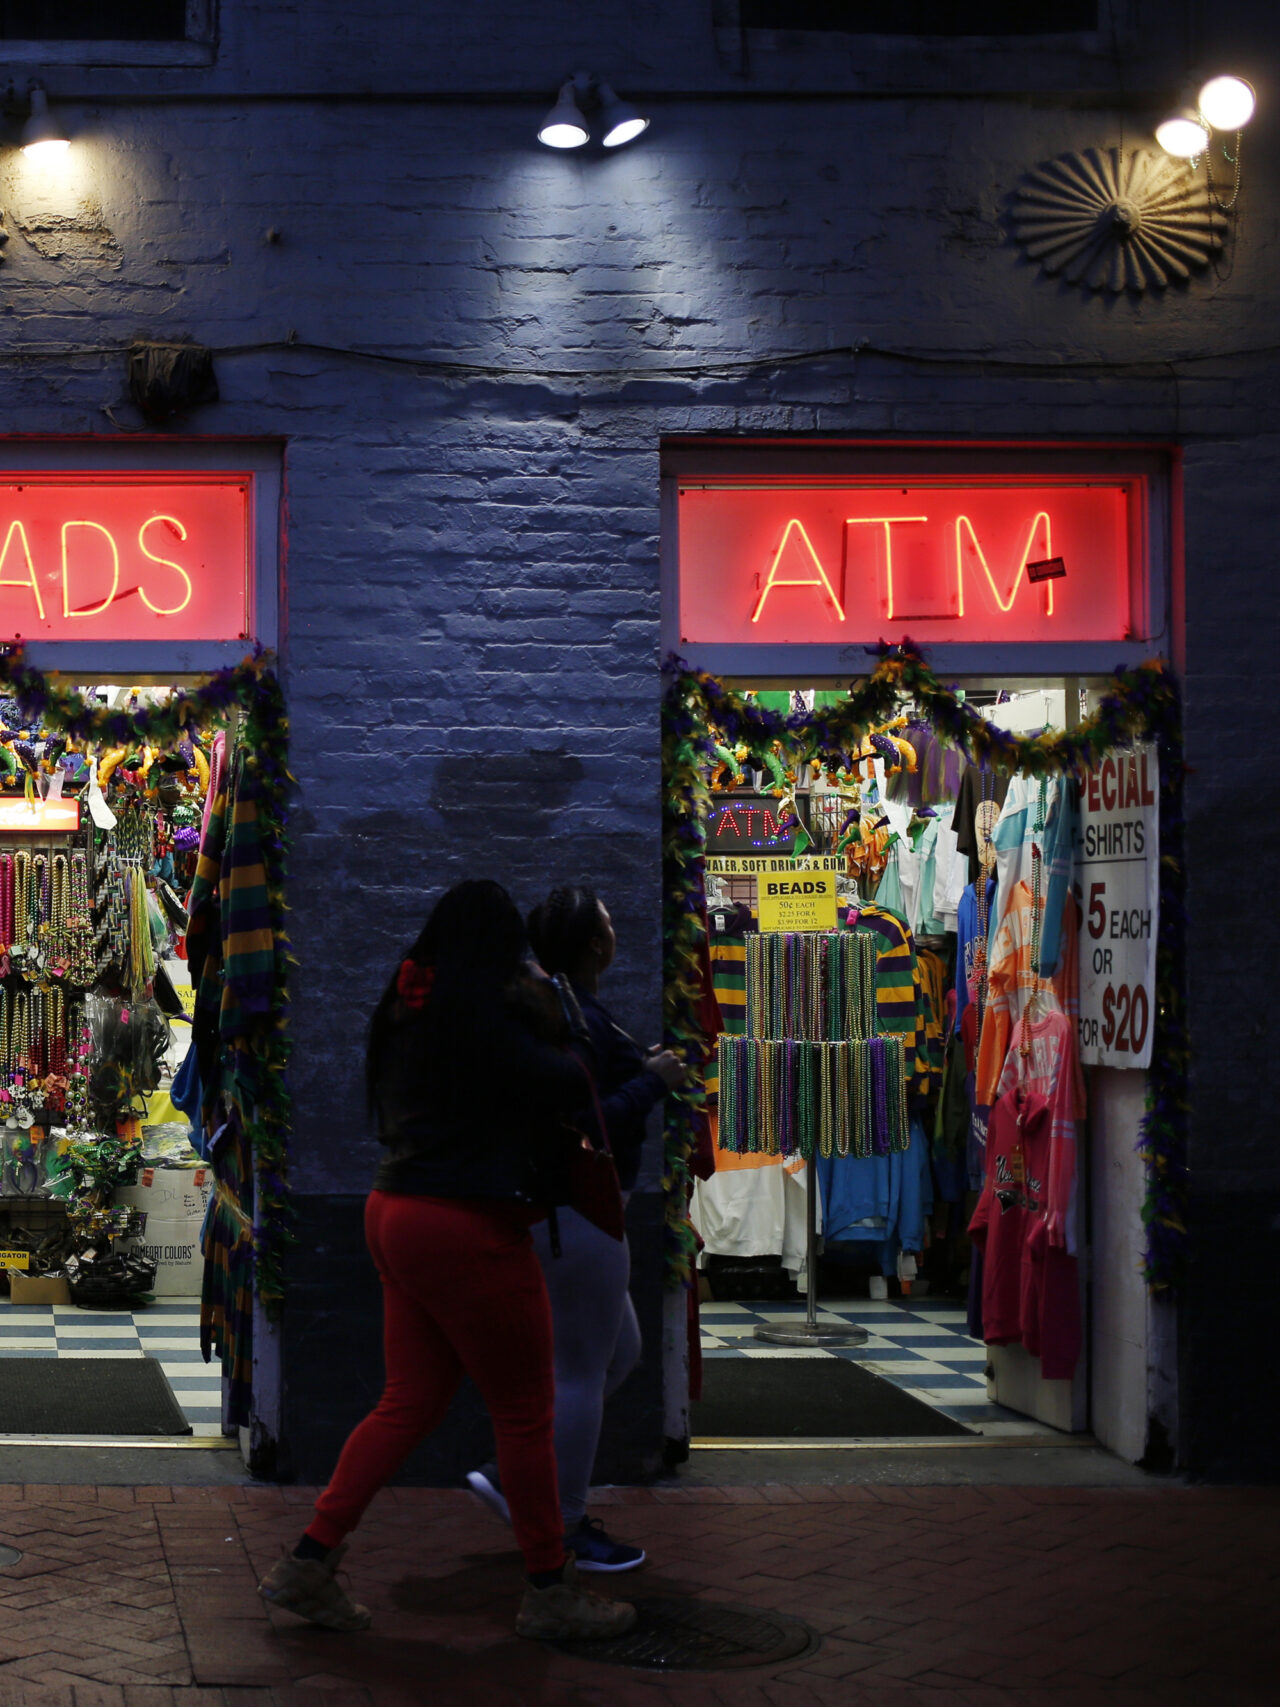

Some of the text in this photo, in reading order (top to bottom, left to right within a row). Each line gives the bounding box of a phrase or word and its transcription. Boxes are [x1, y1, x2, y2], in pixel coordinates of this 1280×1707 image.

[751, 511, 1055, 623] ATM
[715, 809, 789, 837] ATM
[741, 859, 768, 872] SOFT
[770, 858, 811, 871] DRINKS
[813, 858, 821, 870] &
[823, 856, 846, 871] GUM
[767, 881, 827, 896] BEADS
[795, 901, 816, 909] EACH
[1110, 909, 1151, 940] EACH
[1092, 948, 1113, 975] OR
[1101, 981, 1149, 1055] $20
